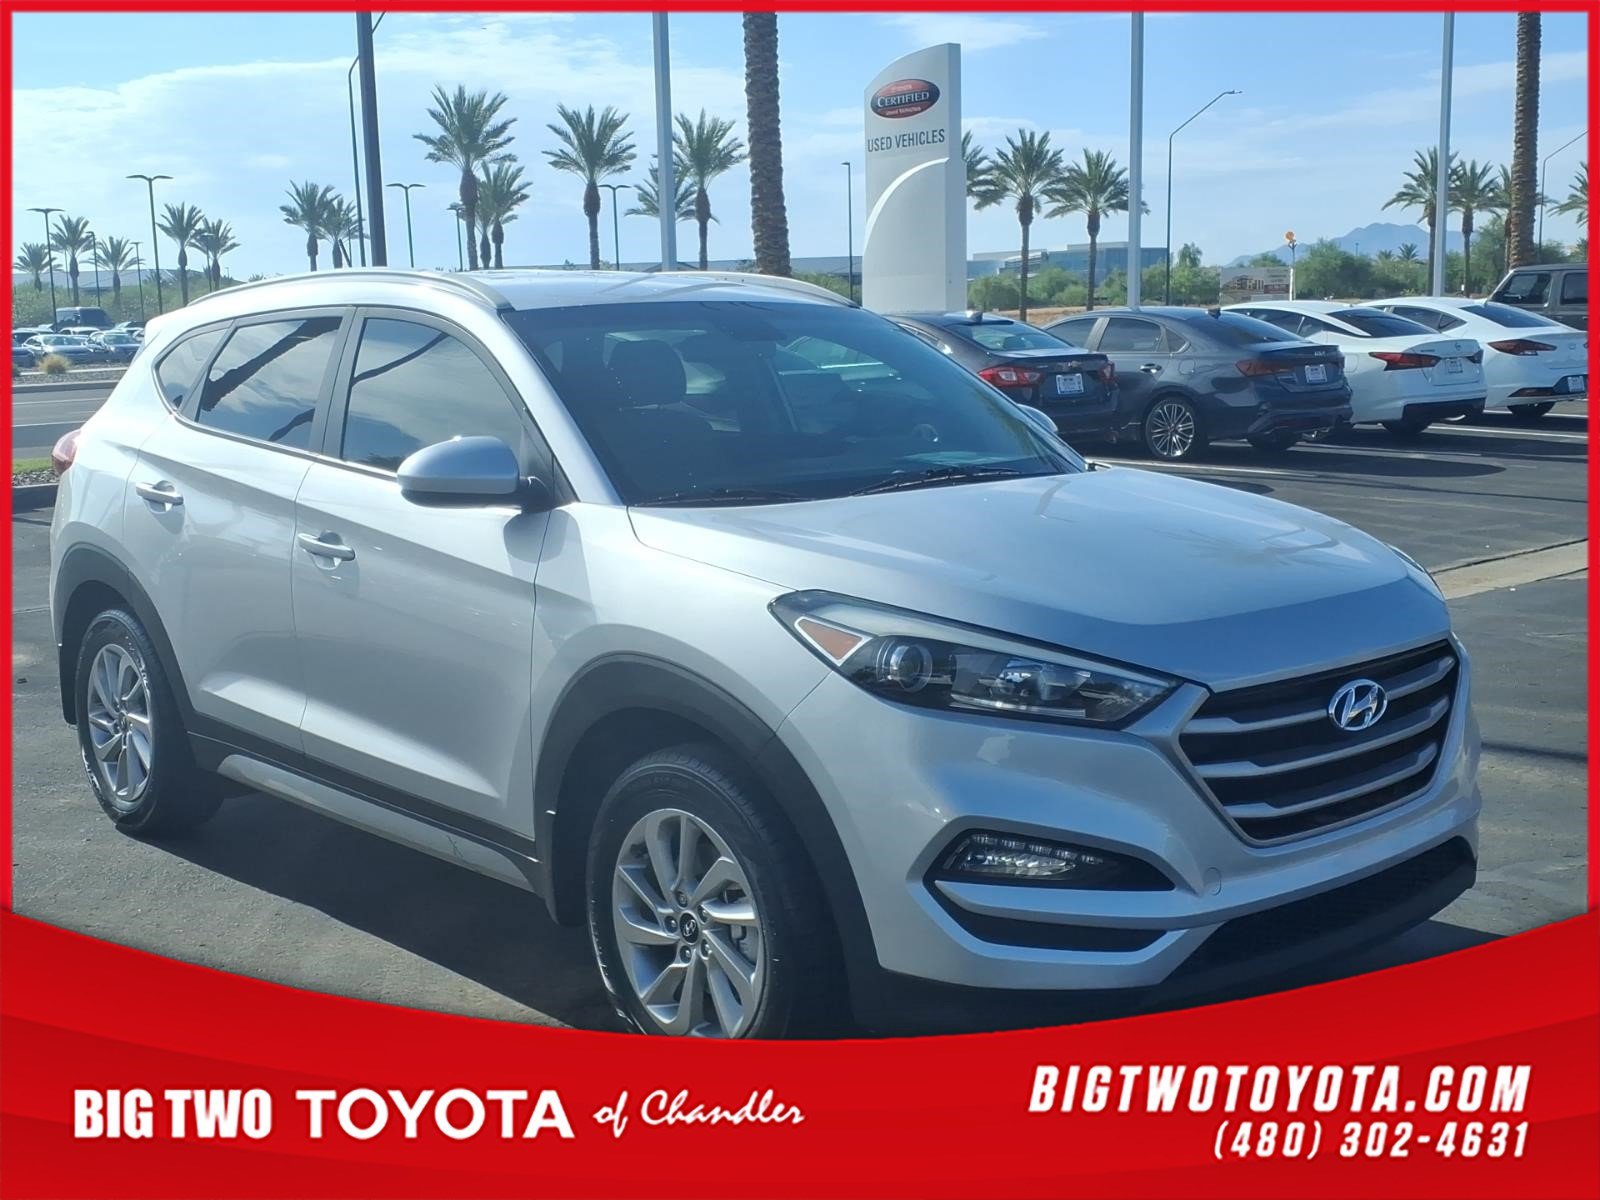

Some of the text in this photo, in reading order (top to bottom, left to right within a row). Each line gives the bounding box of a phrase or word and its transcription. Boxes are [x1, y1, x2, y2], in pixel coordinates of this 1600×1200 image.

[877, 91, 930, 108] CERTIFIED
[867, 128, 945, 152] USED VEHICLES
